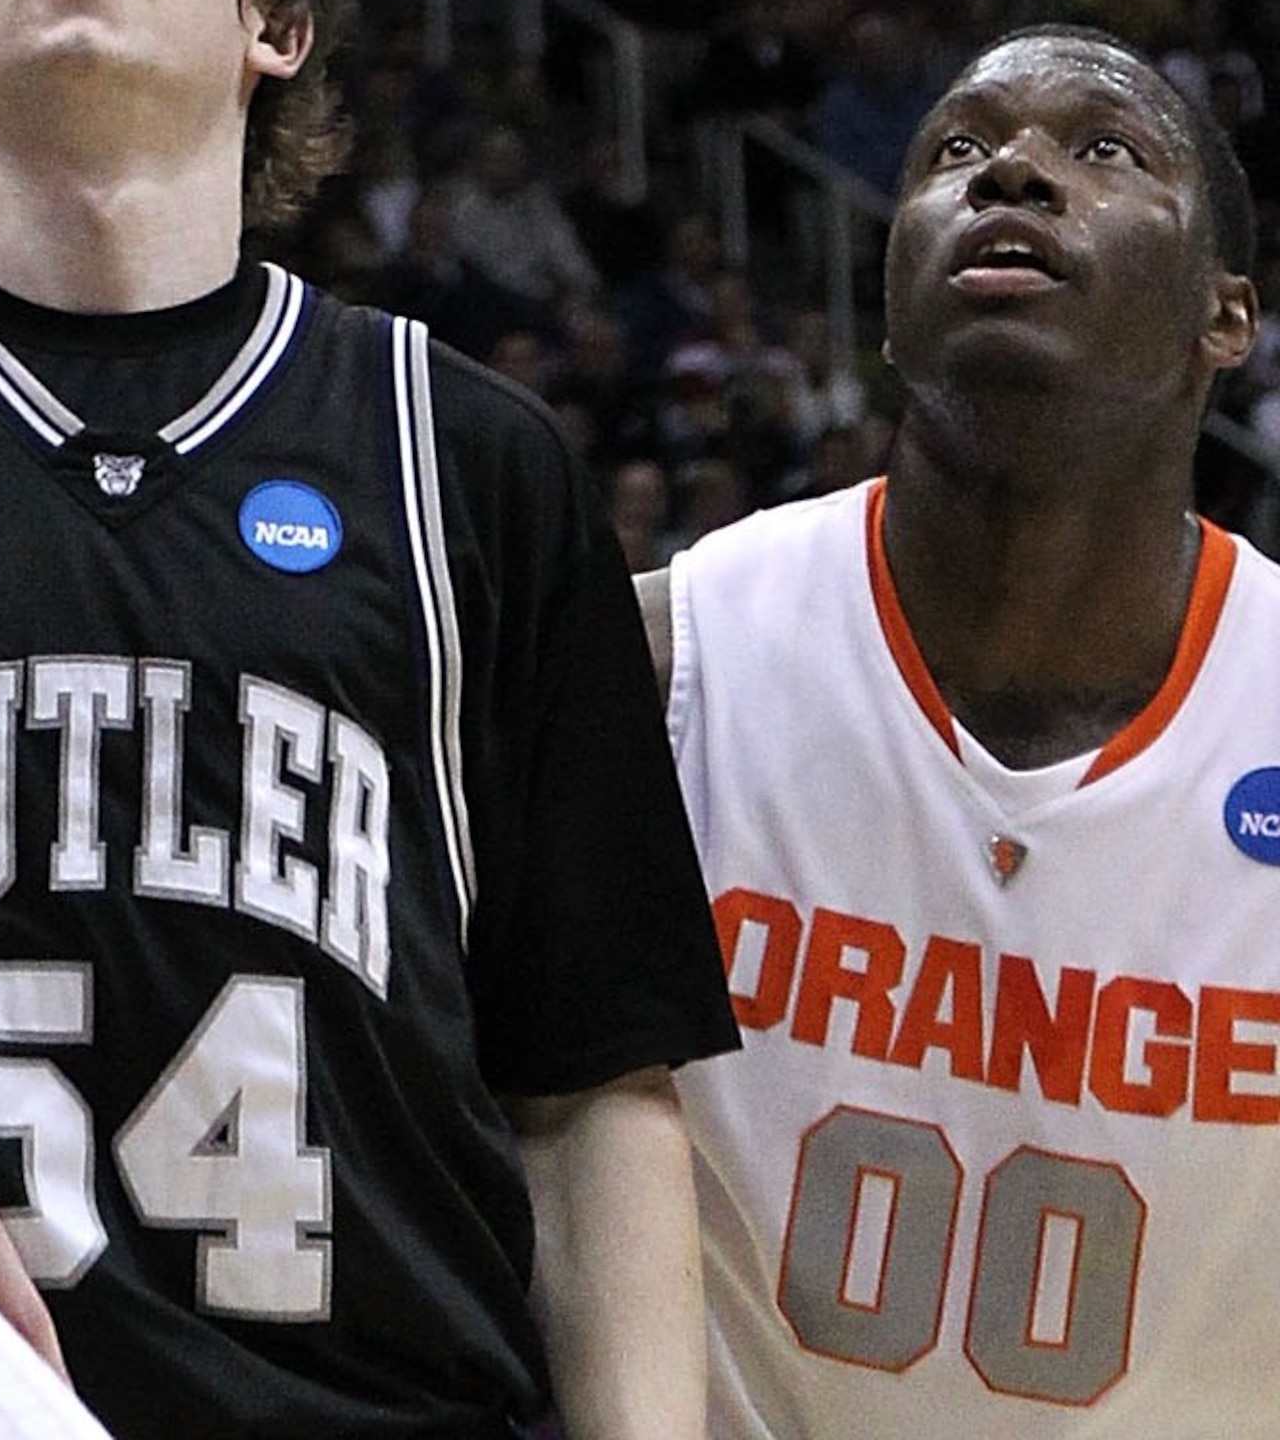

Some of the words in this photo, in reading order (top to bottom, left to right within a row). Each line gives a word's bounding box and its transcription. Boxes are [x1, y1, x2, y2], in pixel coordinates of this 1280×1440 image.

[255, 521, 329, 550] NCAA
[709, 885, 1280, 1125] ORANGE
[776, 1104, 1147, 1407] 00
